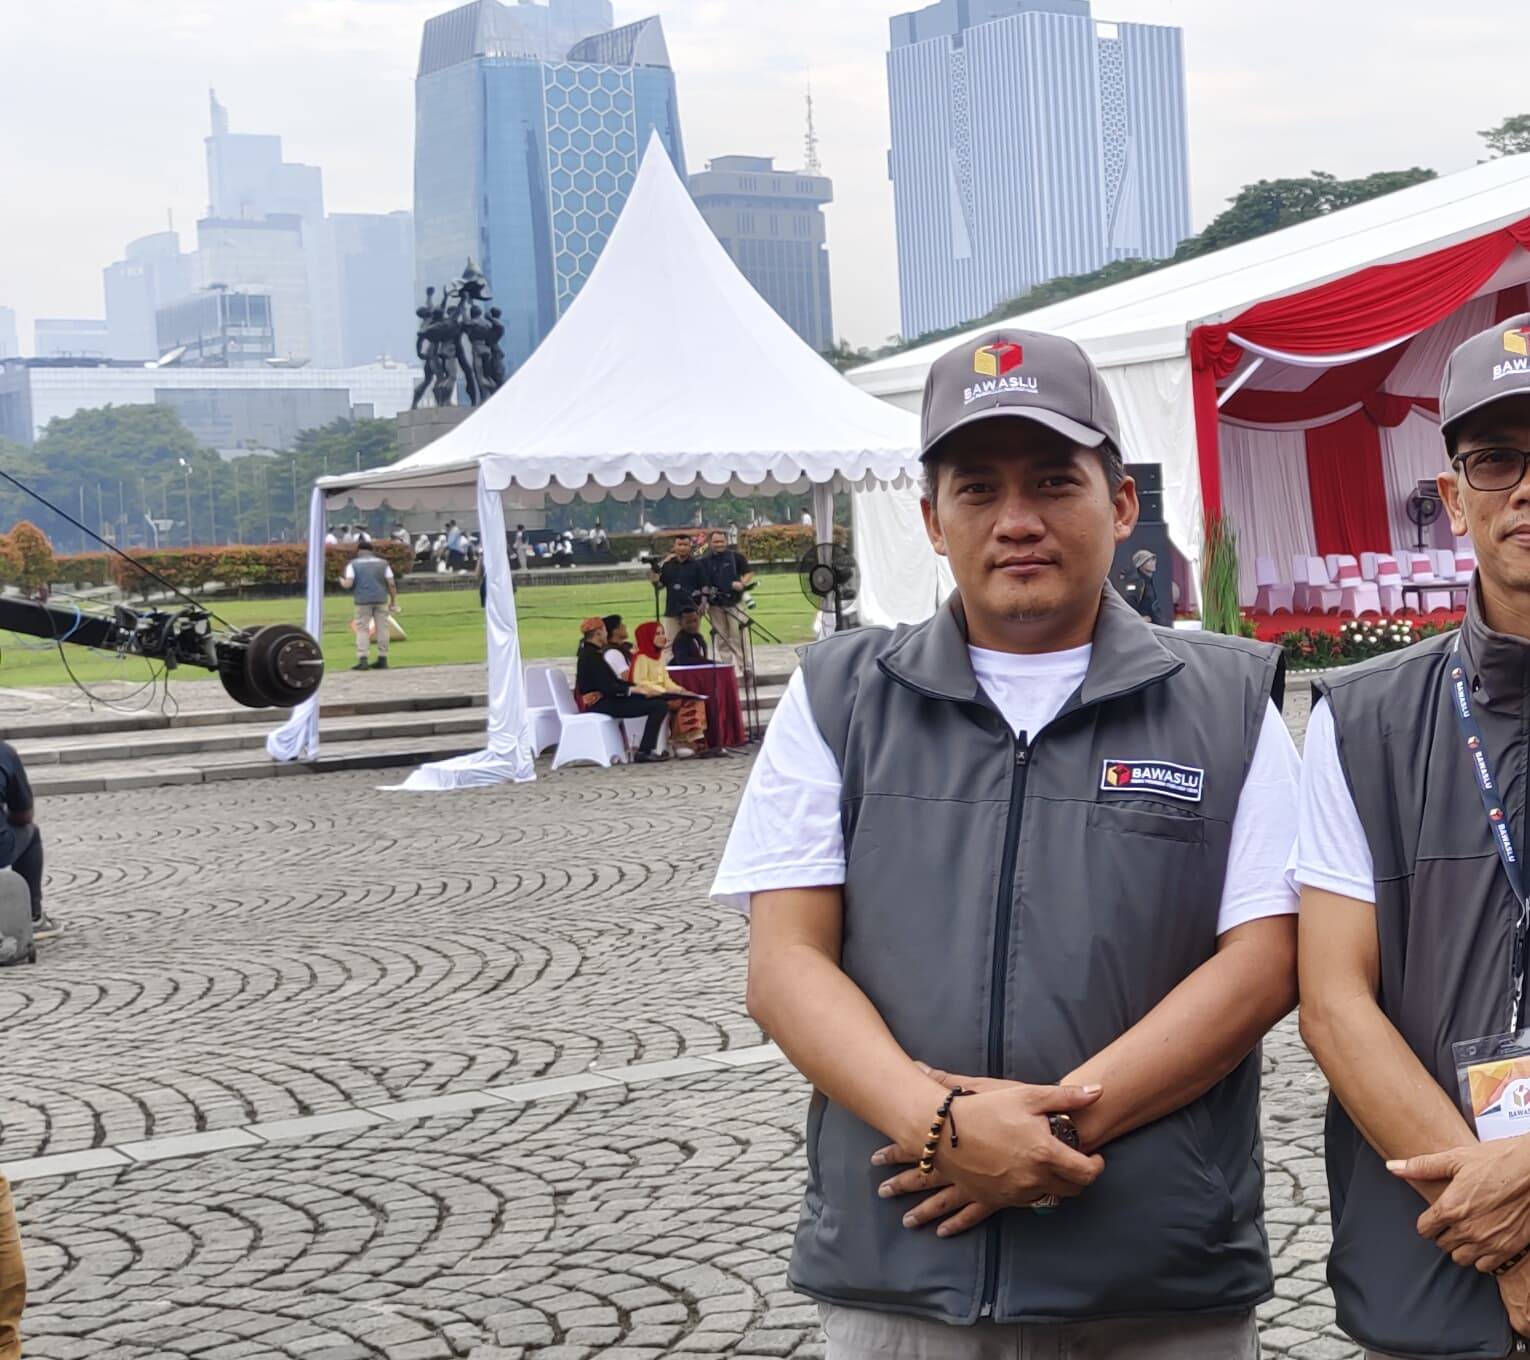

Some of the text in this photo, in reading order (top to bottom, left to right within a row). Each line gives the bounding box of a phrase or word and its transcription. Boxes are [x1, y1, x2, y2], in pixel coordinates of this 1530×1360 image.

[963, 376, 1037, 400] BAWASLU
[1132, 767, 1199, 788] BAWASLU
[1475, 751, 1493, 790] BAWASLU
[1498, 823, 1517, 863] BAWASLU
